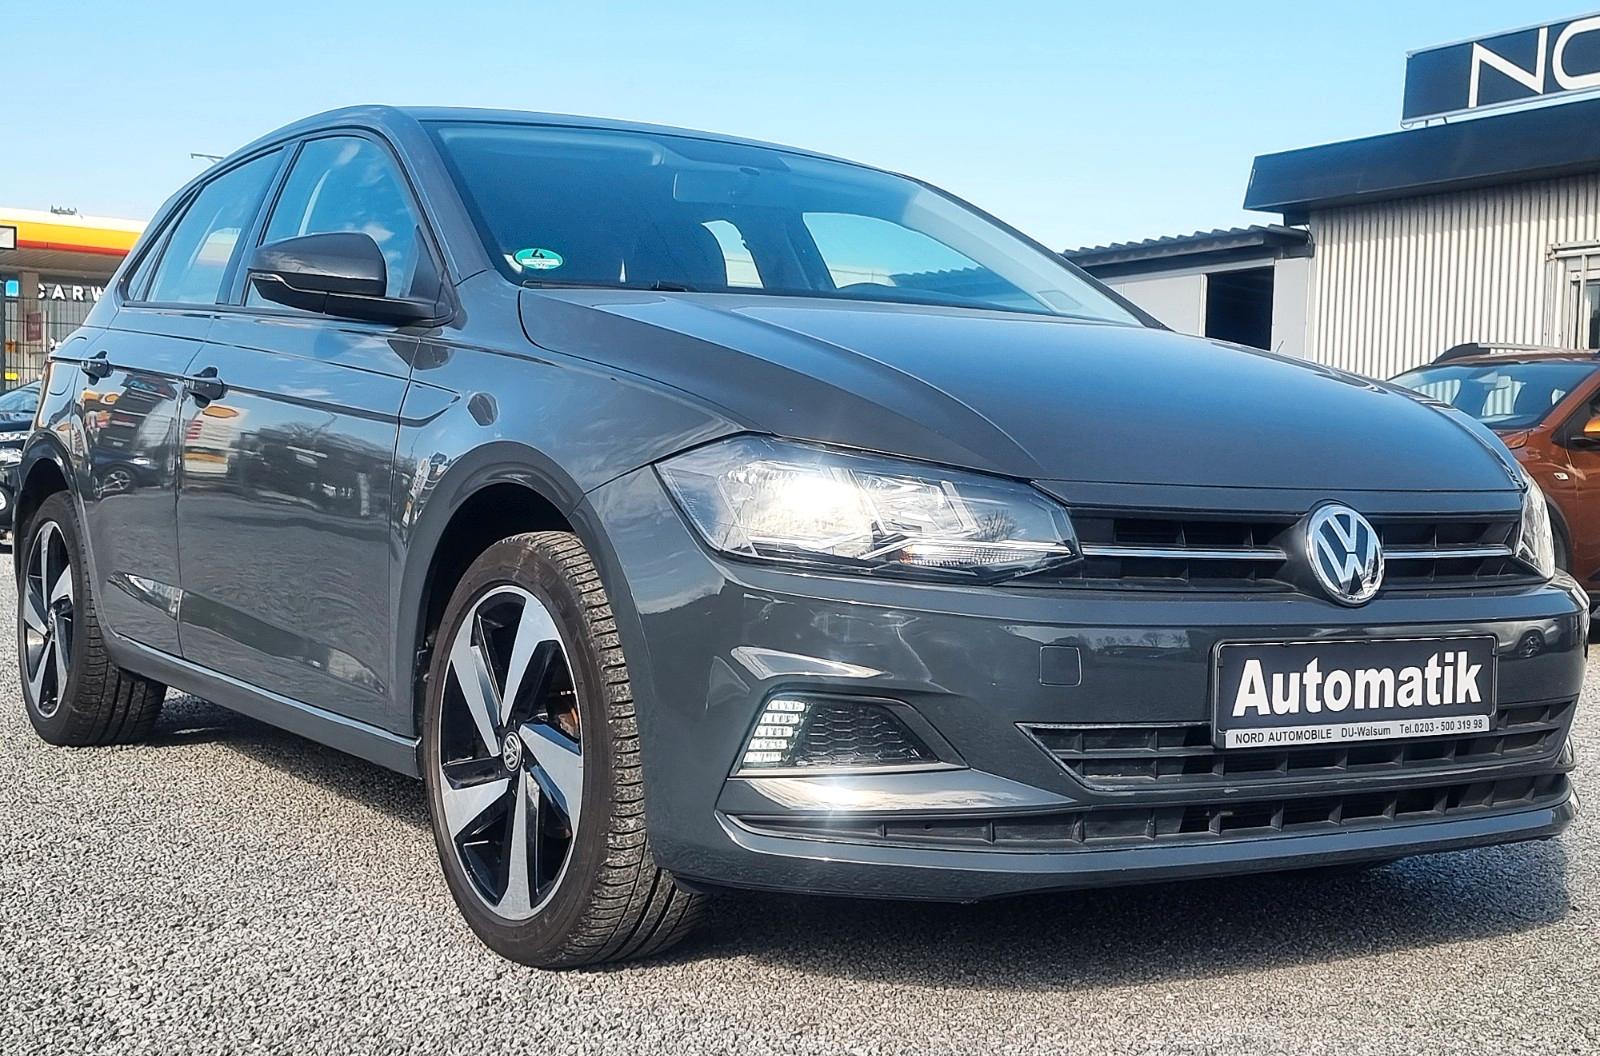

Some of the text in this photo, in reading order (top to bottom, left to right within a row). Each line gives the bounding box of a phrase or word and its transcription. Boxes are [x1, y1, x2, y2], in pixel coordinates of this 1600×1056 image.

[1306, 505, 1384, 605] VW
[1232, 651, 1482, 717] Automatik
[1235, 732, 1265, 744] NORD
[1268, 728, 1332, 742] AUTOMOBILE
[1341, 726, 1391, 738] DU-Walsum
[1441, 721, 1455, 731] 500
[1457, 720, 1471, 730] 319
